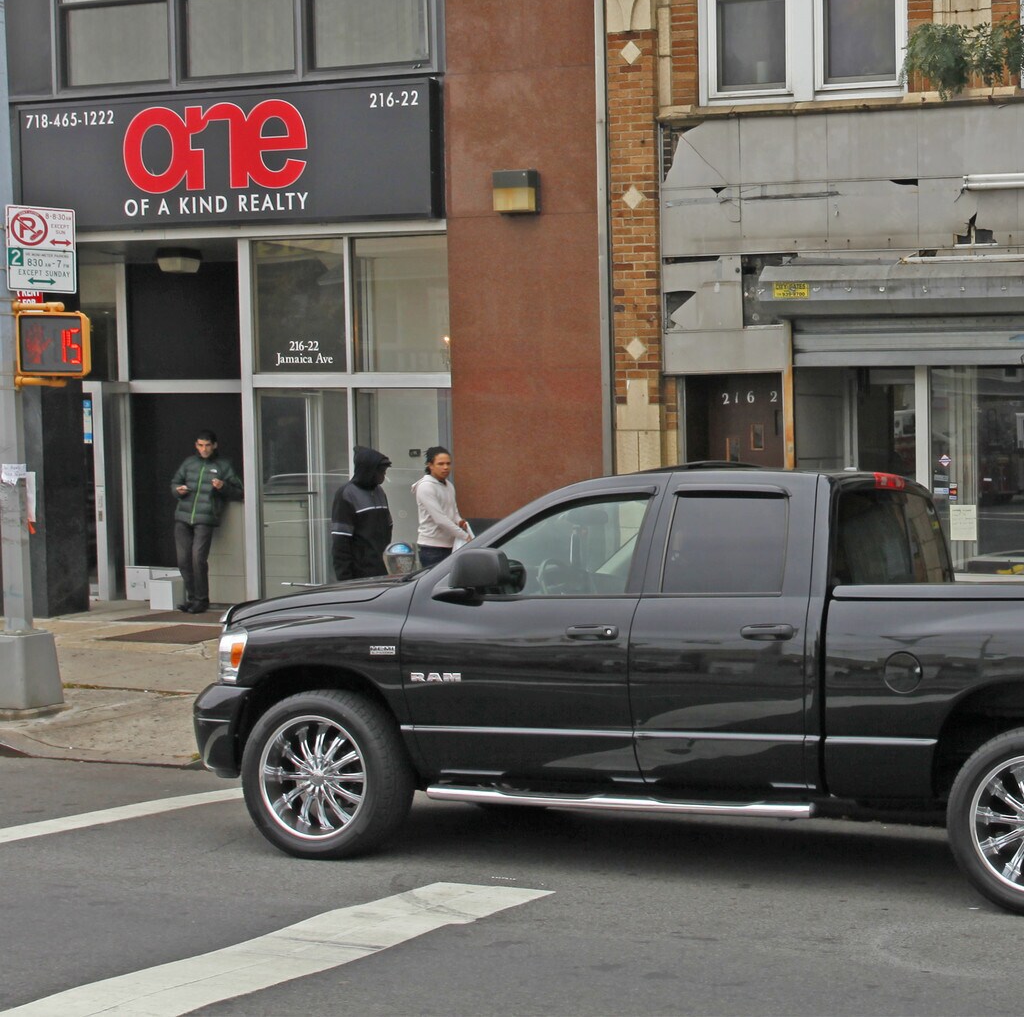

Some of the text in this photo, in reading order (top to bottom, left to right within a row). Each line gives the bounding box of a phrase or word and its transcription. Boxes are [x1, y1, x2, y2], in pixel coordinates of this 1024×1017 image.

[369, 90, 419, 109] 216-22
[25, 110, 115, 130] 718-465-1222
[123, 98, 308, 194] one
[124, 191, 309, 217] OF A KIND REALTY
[11, 249, 21, 265] 2
[18, 268, 70, 278] EXCEPT SUNDAY
[289, 340, 320, 352] 216-22
[275, 352, 334, 367] Jamaica Ave
[410, 672, 462, 683] RAM
